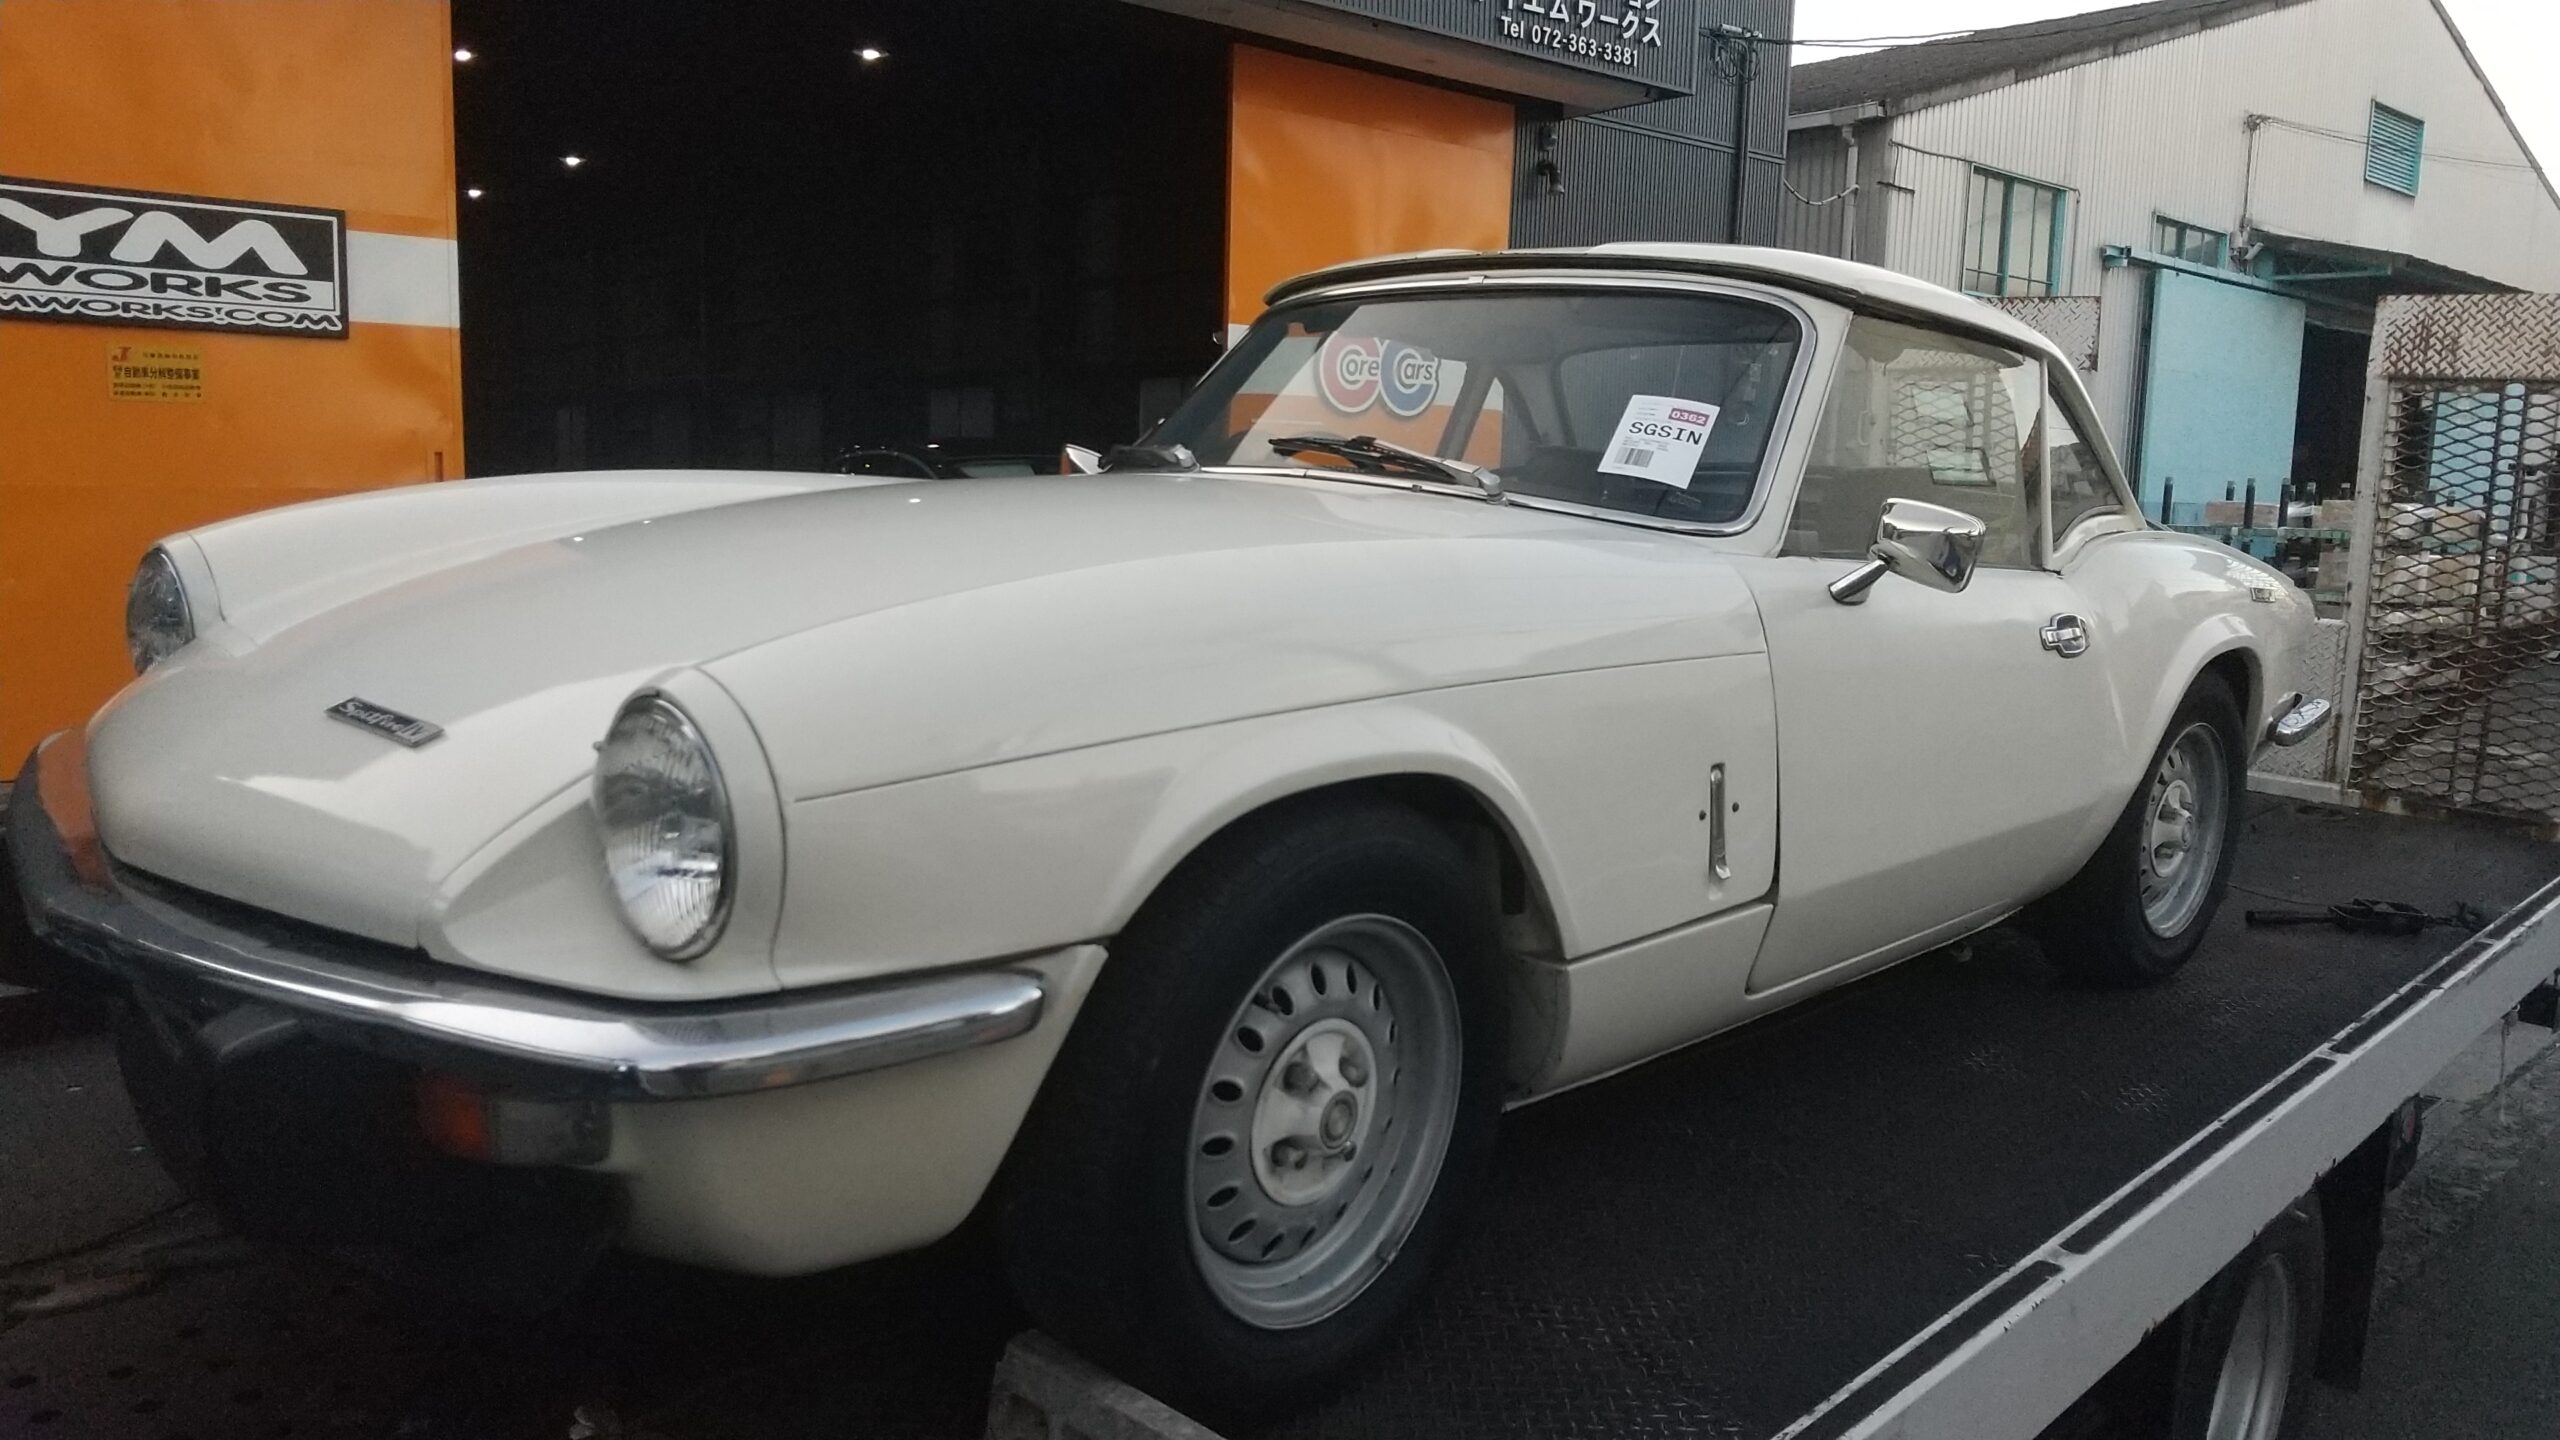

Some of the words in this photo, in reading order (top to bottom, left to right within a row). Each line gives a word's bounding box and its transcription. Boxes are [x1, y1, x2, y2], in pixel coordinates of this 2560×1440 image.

[1501, 15, 1524, 39] Tel
[1532, 25, 1638, 67] 072-363-3381
[0, 262, 312, 303] WORKS
[1628, 421, 1703, 446] SGSIN
[1671, 409, 1707, 425] 0362
